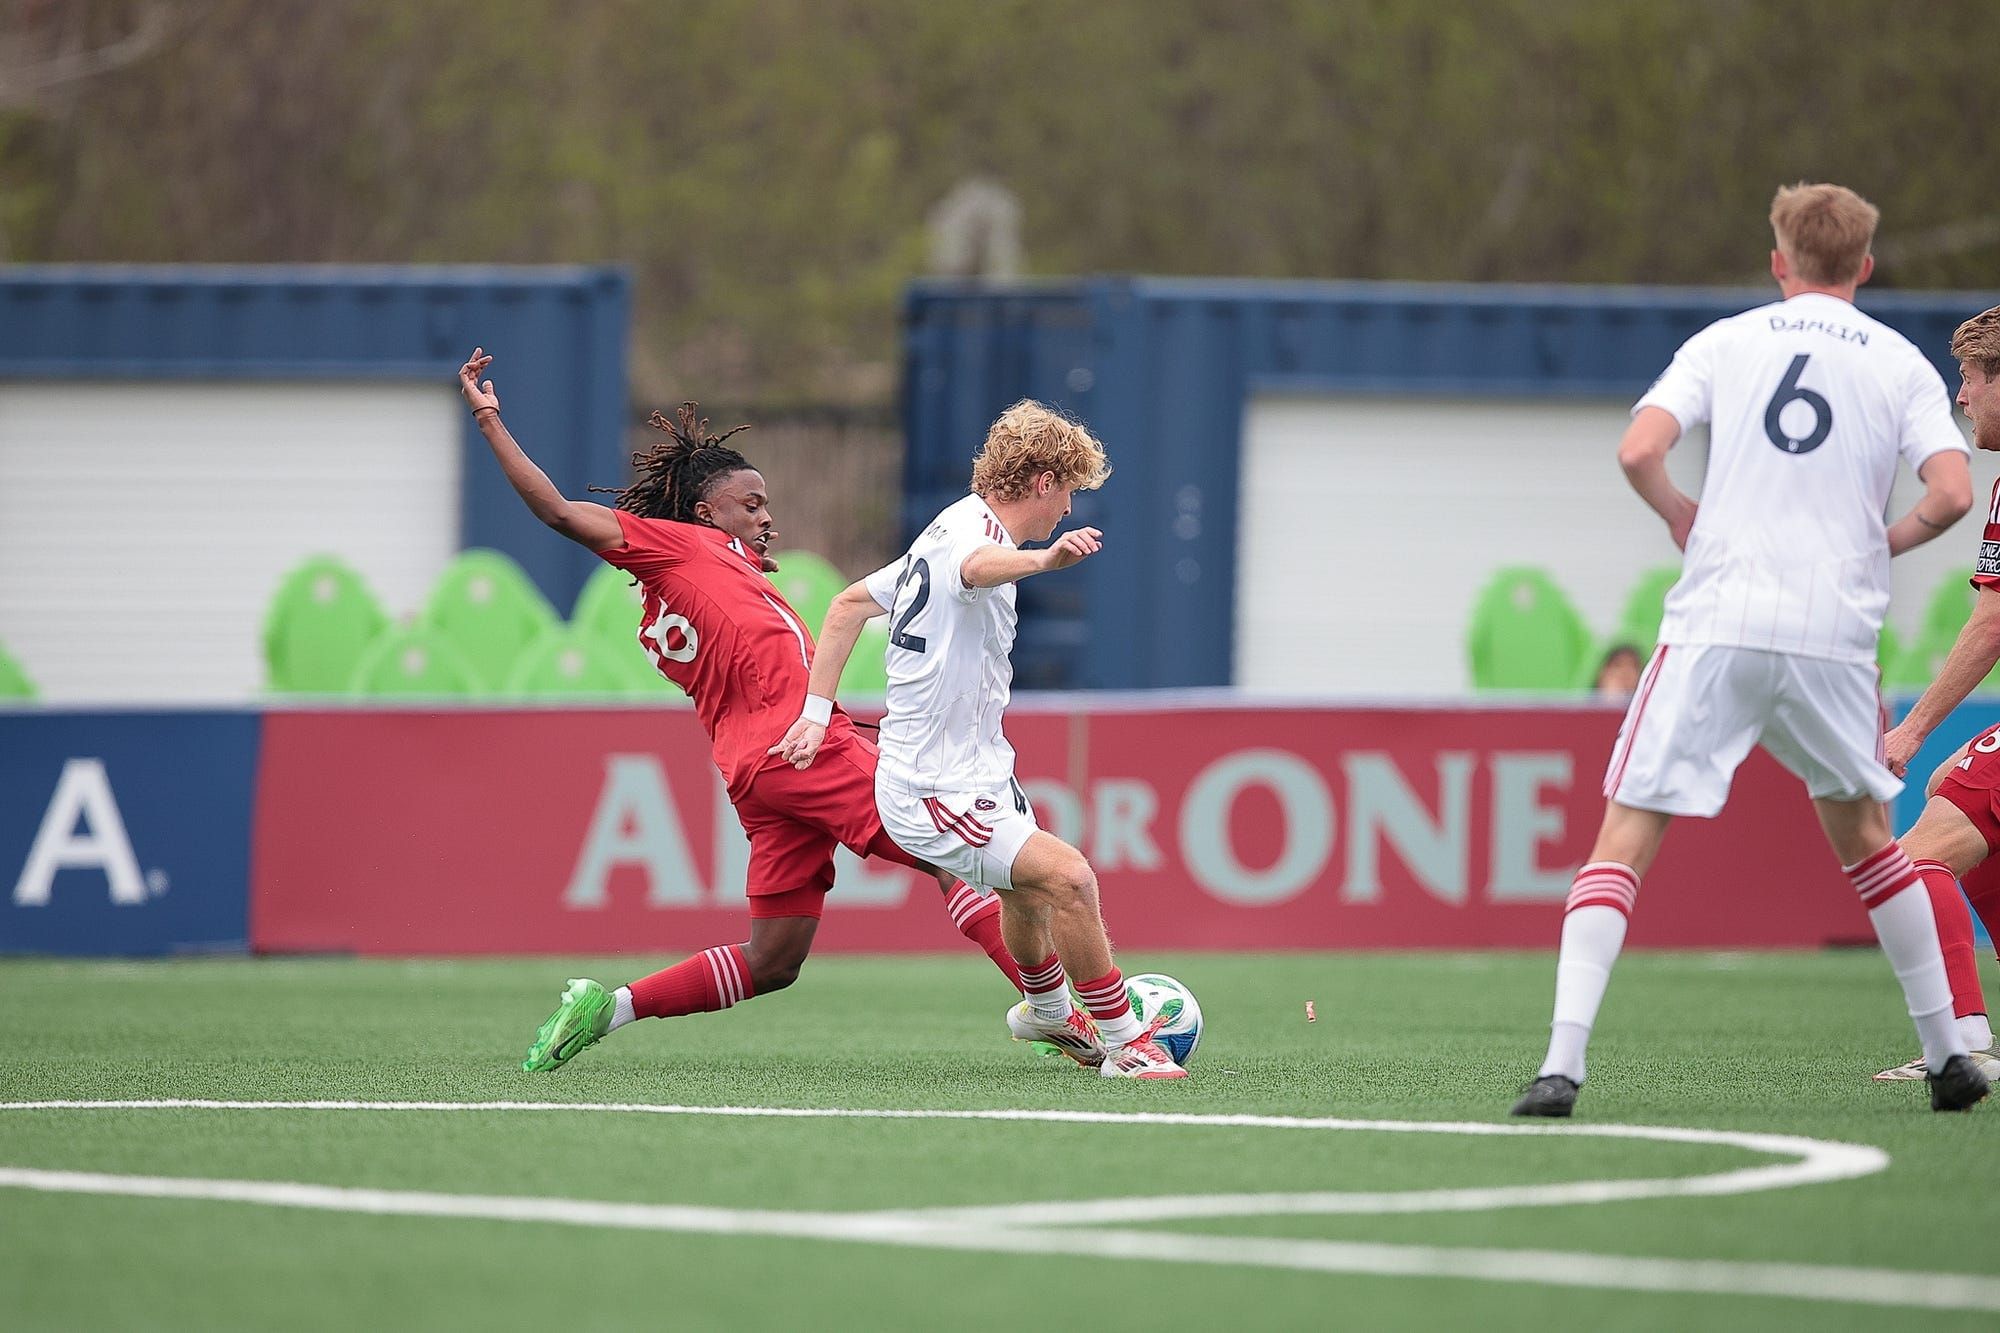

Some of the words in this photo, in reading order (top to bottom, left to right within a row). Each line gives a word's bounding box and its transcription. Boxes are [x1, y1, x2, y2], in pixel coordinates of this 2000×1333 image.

[1769, 315, 1870, 347] DAHLIN
[1764, 353, 1833, 455] 6
[1024, 777, 1166, 871] OR
[1178, 746, 1580, 908] ONE
